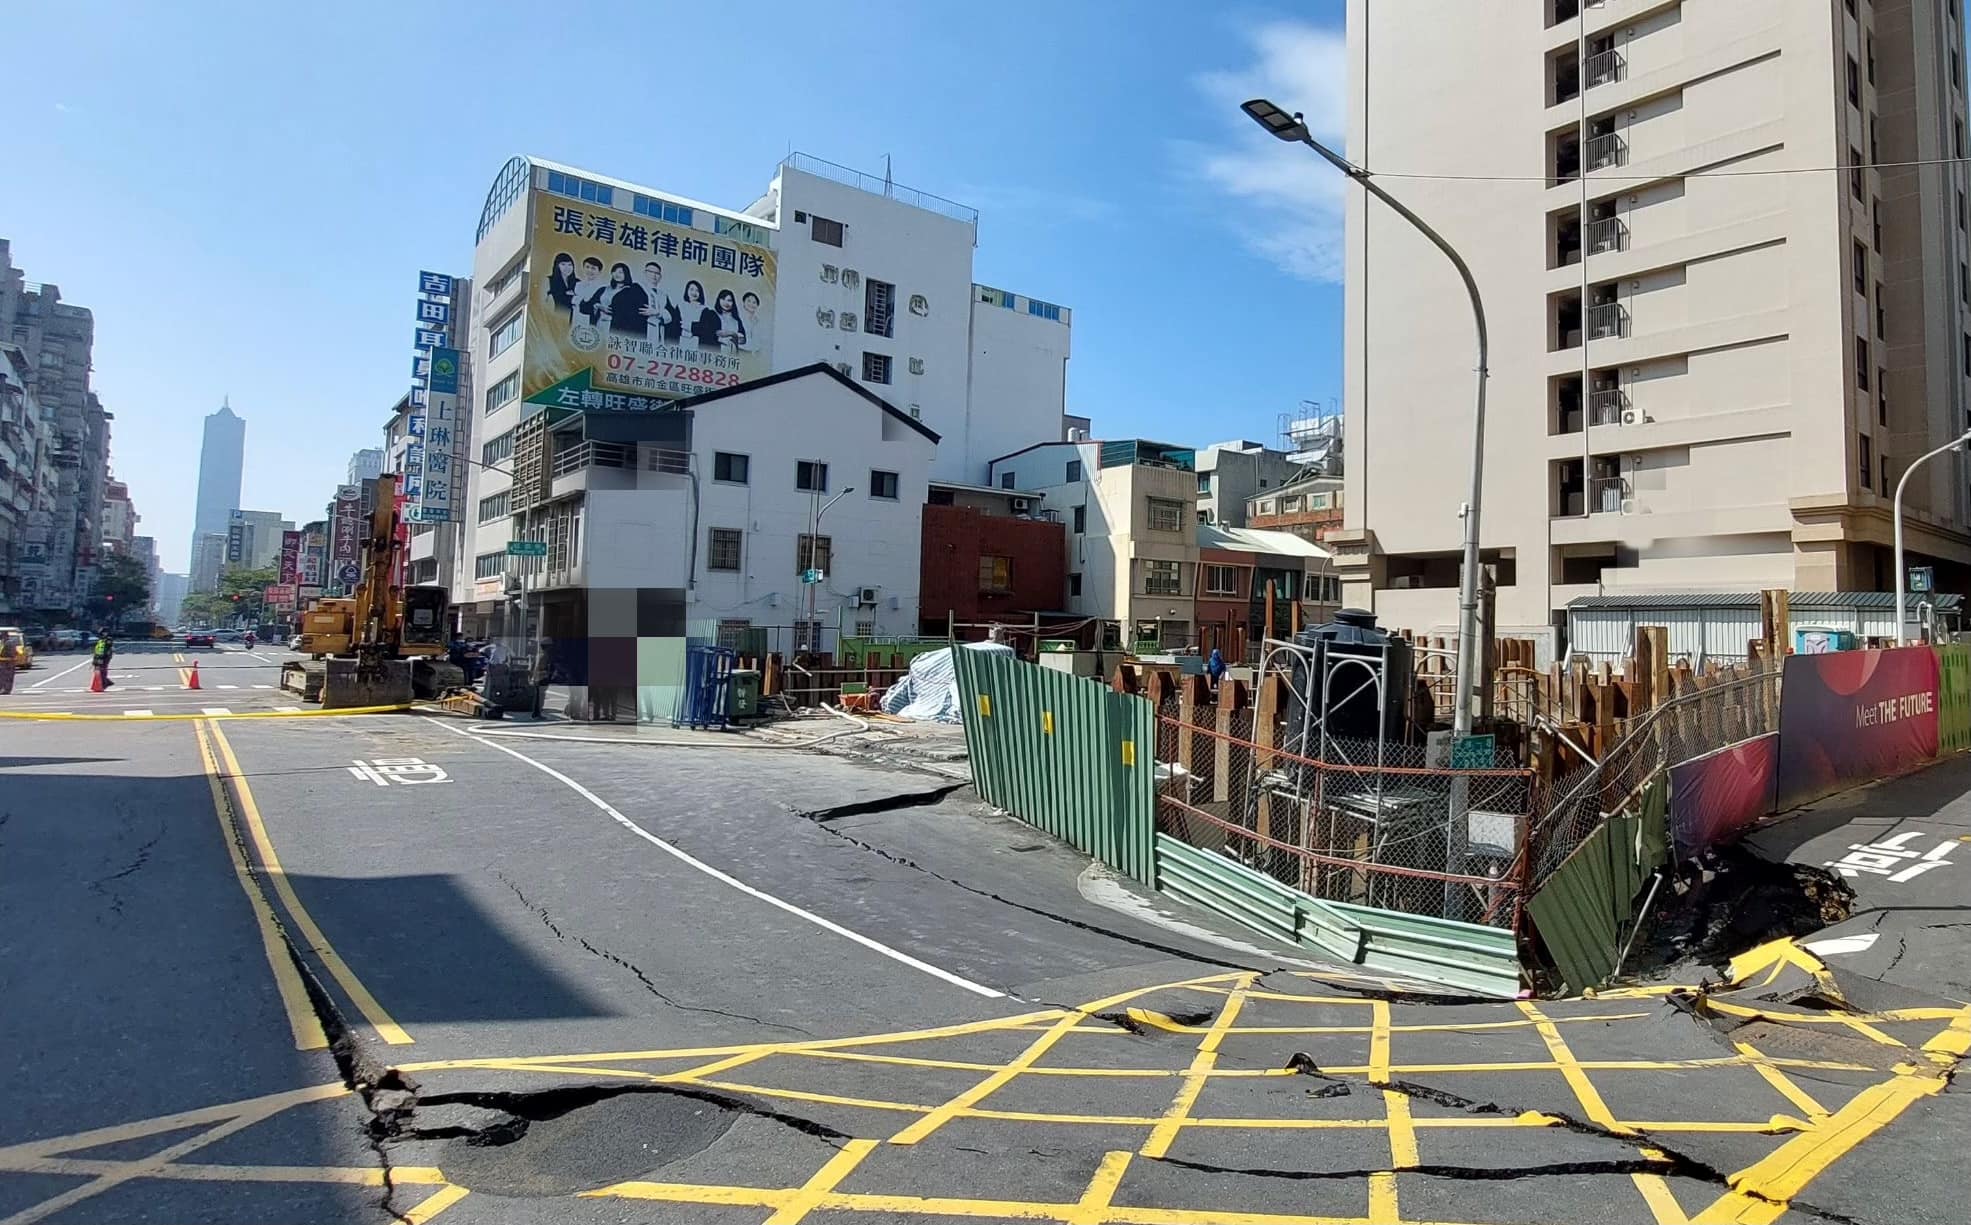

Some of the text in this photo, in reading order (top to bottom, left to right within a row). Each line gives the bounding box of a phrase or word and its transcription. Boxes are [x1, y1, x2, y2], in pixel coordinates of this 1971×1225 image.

[554, 206, 765, 278] 張清雄律師團隊
[607, 335, 741, 371] 詠智聯合律師事務所
[607, 353, 740, 387] 07-2728828
[1856, 691, 1934, 729] Meet THE FUTURE
